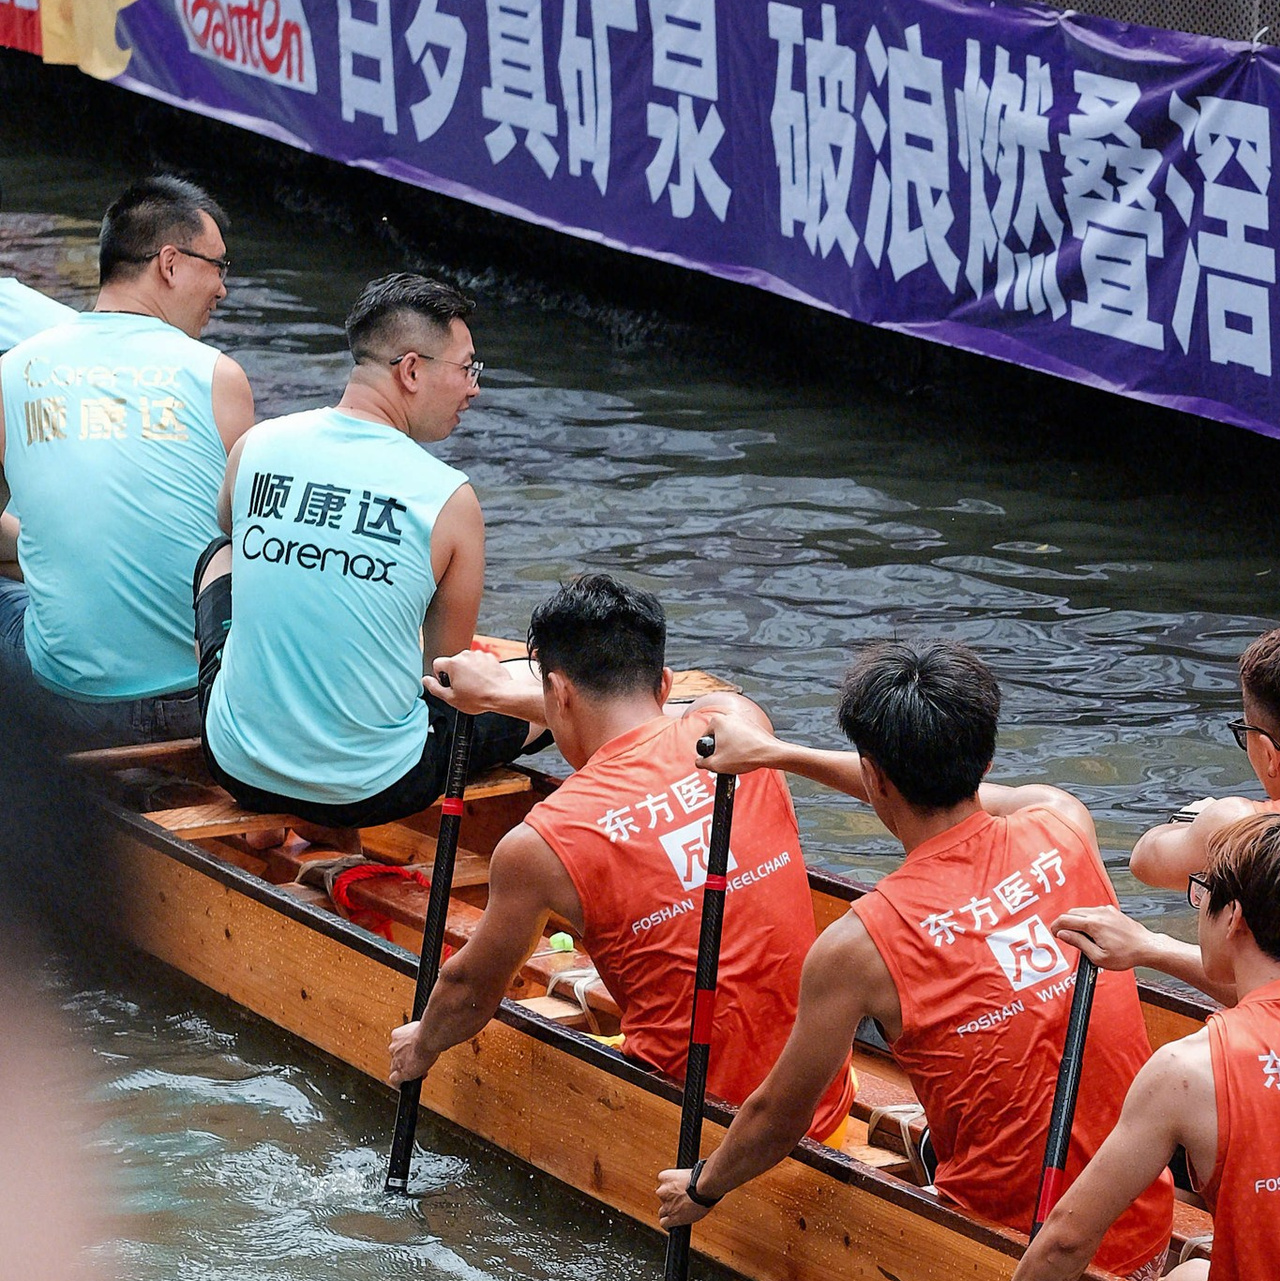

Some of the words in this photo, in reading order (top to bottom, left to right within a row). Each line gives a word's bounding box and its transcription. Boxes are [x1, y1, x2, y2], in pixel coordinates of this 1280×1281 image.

[767, 1, 1276, 377] 破浪燃叠滘
[24, 394, 190, 448] 顺康达
[247, 472, 408, 545] 顺康达
[632, 898, 695, 935] FOSHAN
[725, 851, 791, 896] HEELCHAIR
[920, 848, 1067, 947] 东方医疗
[957, 999, 1025, 1038] FOSHAN
